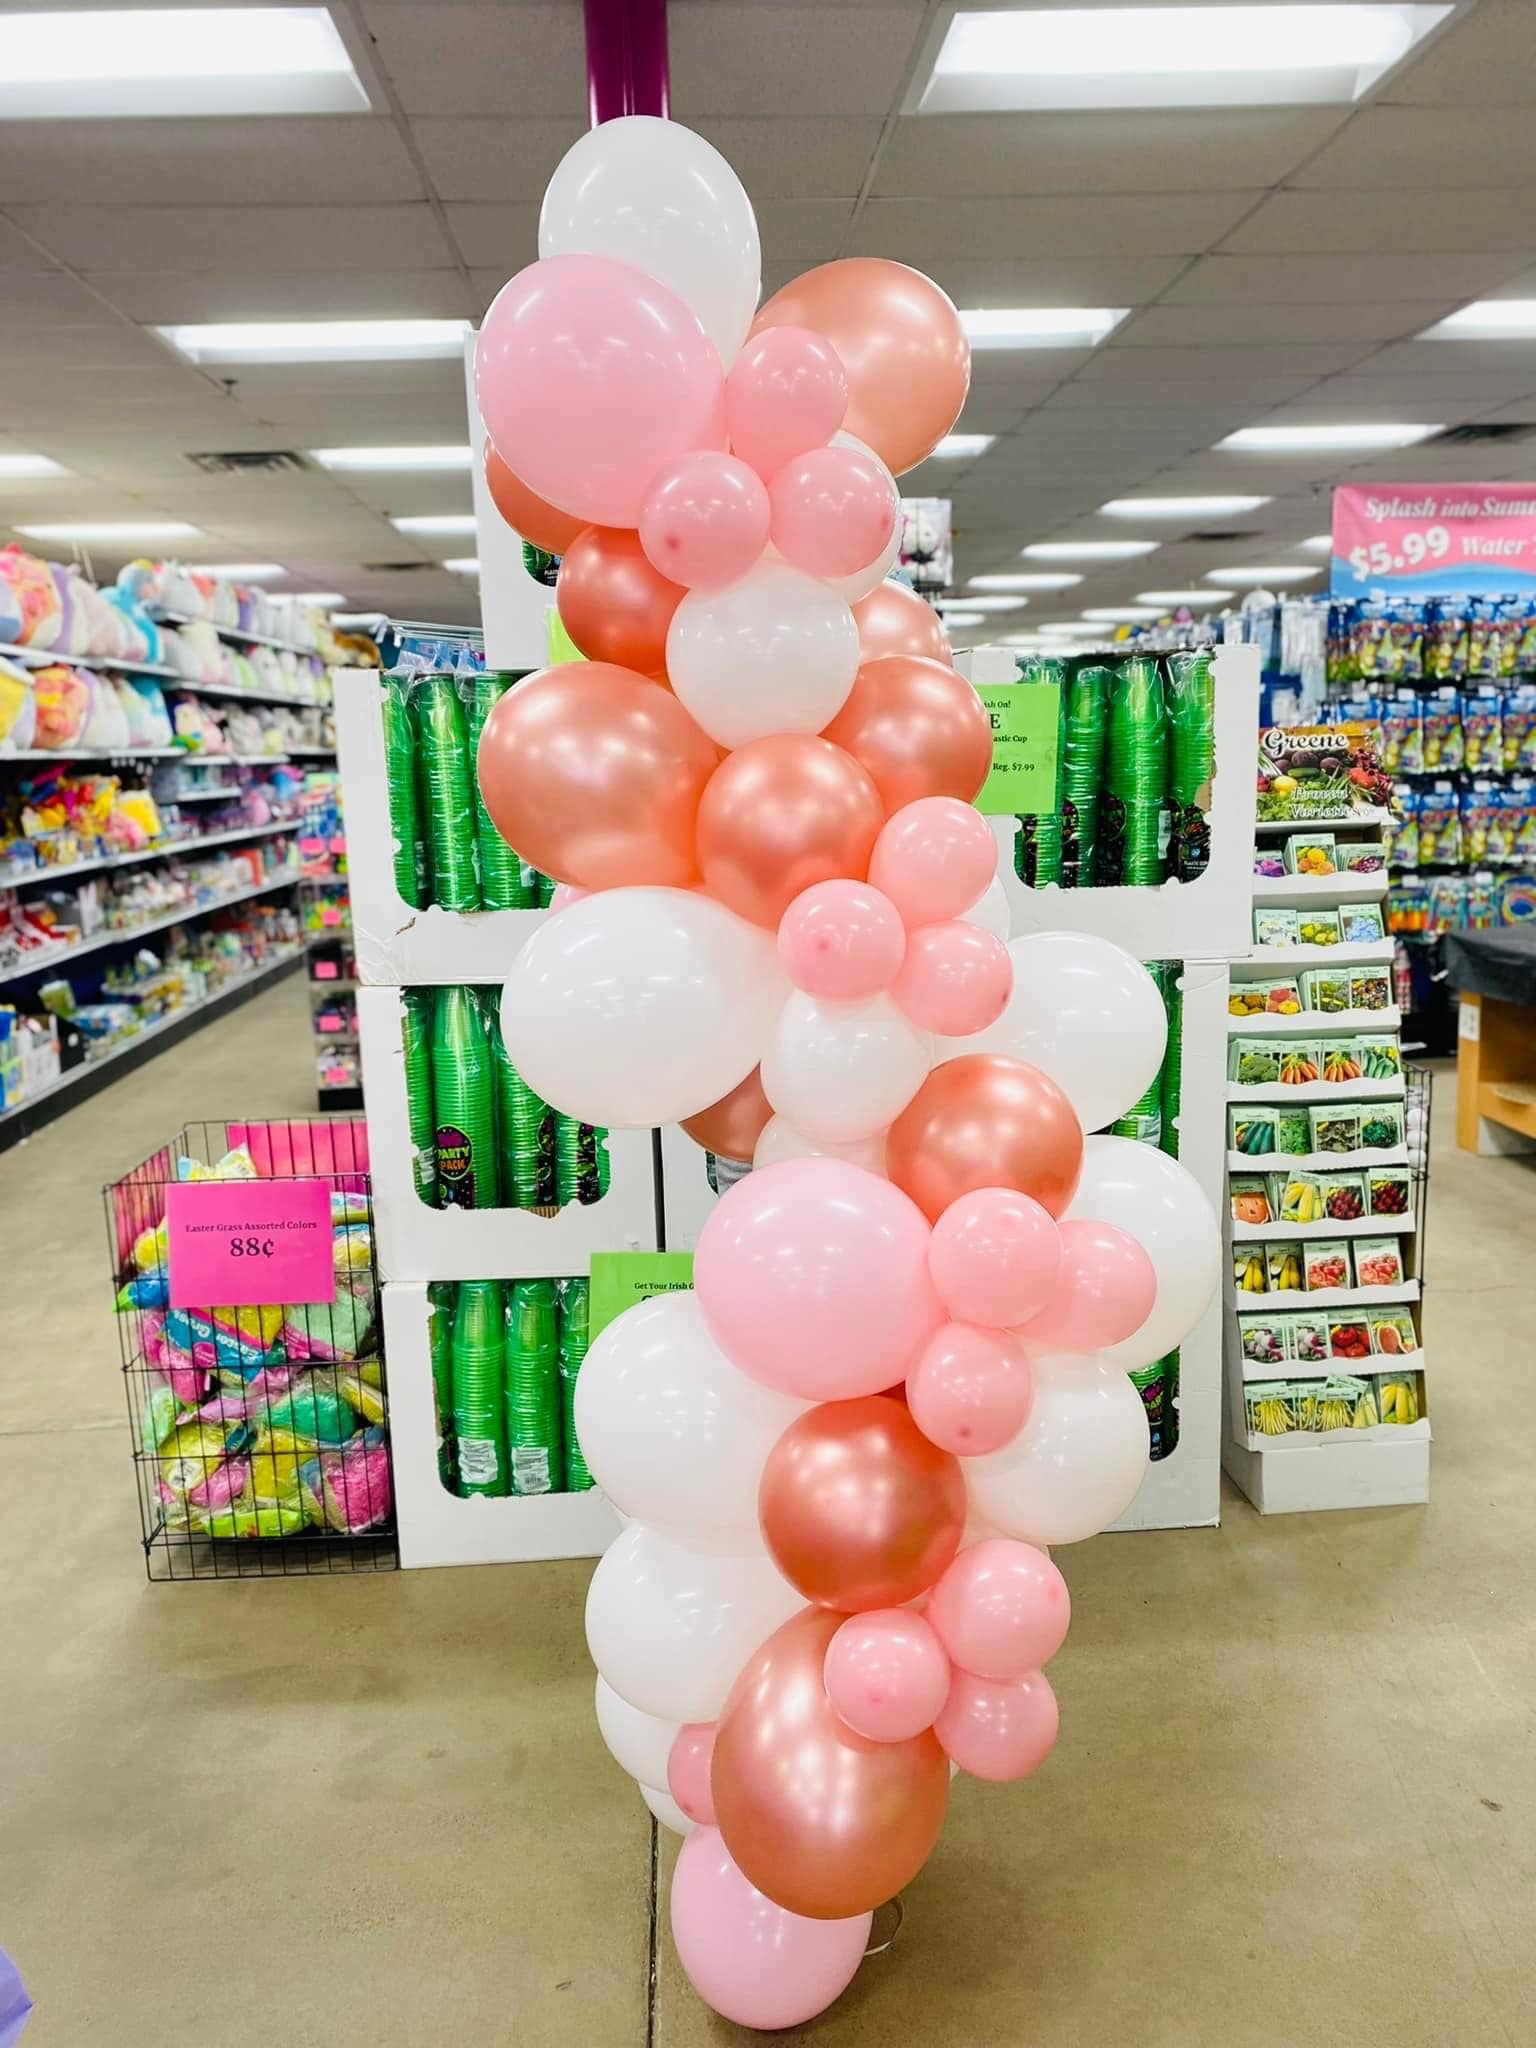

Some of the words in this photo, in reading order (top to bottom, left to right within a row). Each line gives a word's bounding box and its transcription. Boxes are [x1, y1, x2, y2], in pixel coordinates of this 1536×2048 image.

[1365, 497, 1437, 523] Splash
[1441, 499, 1479, 518] into
[1350, 526, 1450, 582] $5.99
[1461, 536, 1527, 556] Water
[1012, 735, 1028, 743] Cup
[1264, 728, 1347, 757] Greene
[993, 763, 1010, 772] Reg.
[1012, 763, 1035, 771] $7.99
[437, 1145, 470, 1159] PARTY
[216, 1224, 242, 1232] Grass
[244, 1222, 285, 1231] Assorted
[287, 1221, 317, 1229] Colors
[230, 1237, 275, 1258] 88¢
[634, 1282, 648, 1290] Get
